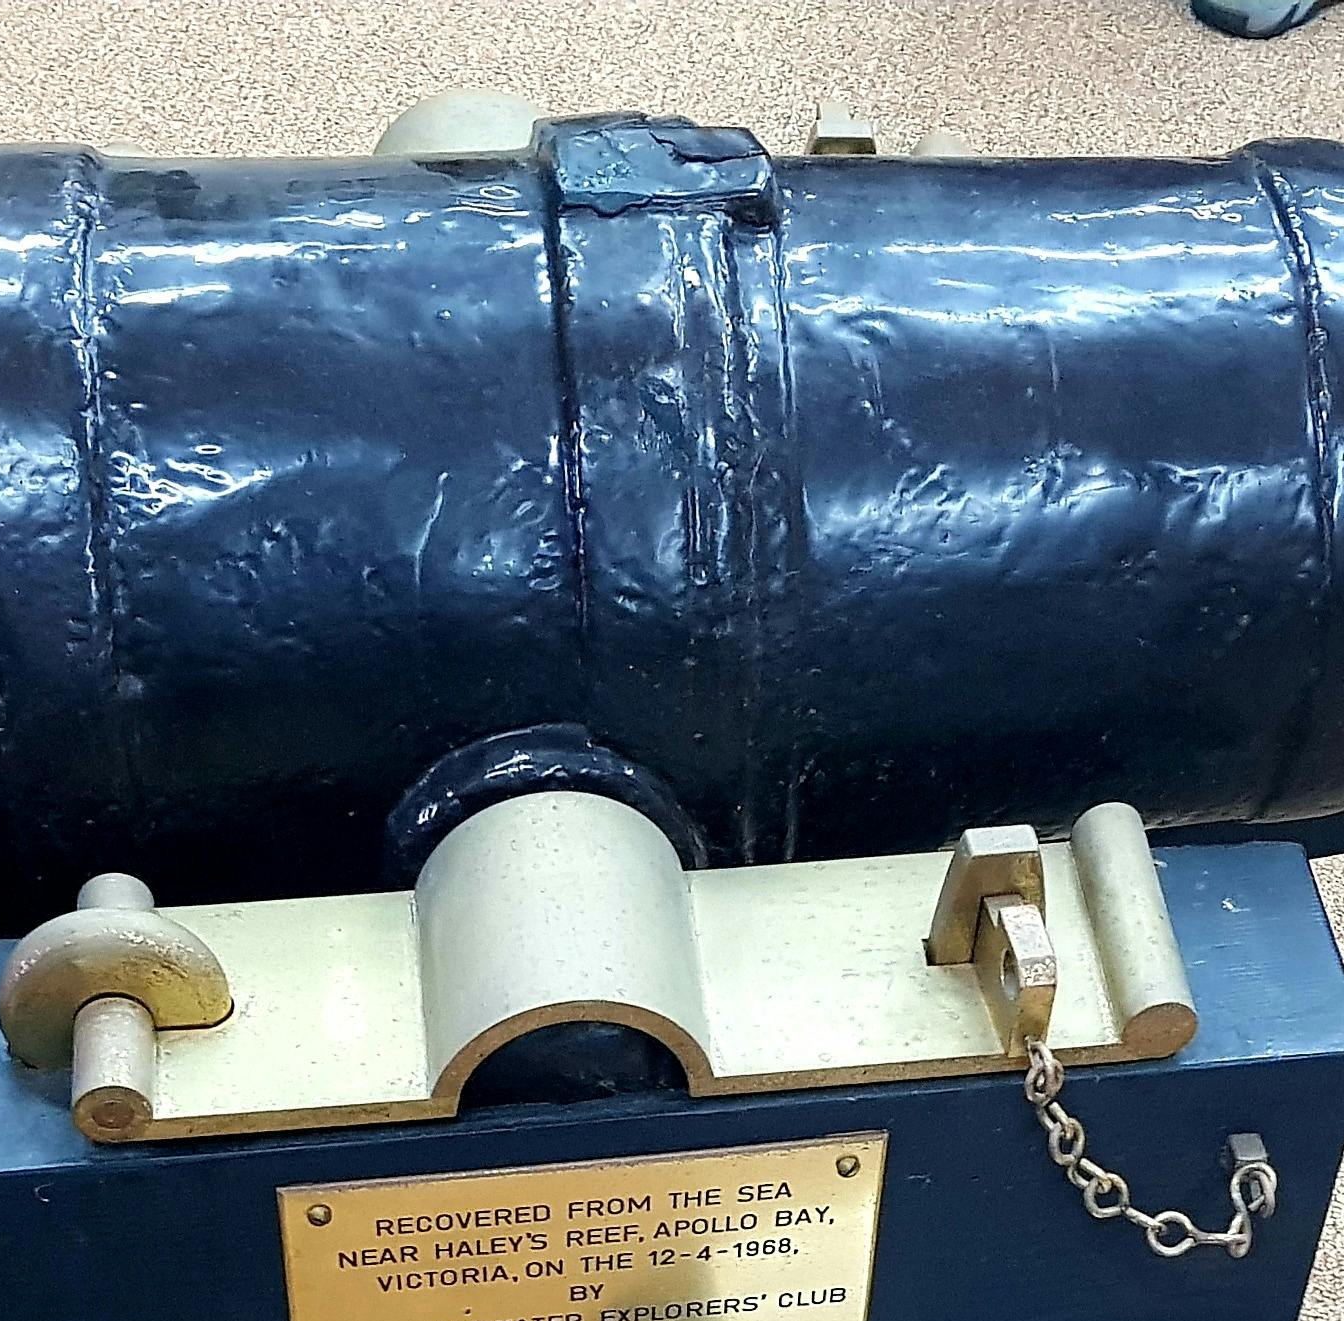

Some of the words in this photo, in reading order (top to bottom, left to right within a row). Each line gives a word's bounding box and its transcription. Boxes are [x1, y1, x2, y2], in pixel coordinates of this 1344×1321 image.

[375, 1204, 551, 1237] RECOVERED
[568, 1195, 651, 1220] FROM
[669, 1188, 721, 1209] THE
[737, 1182, 792, 1203] SEA
[338, 1245, 418, 1269] NEAR
[434, 1232, 548, 1260] HALEY'S
[567, 1224, 645, 1248] REEF,
[653, 1213, 758, 1239] APOLLO
[775, 1206, 835, 1227] BAY,
[377, 1265, 518, 1292] VICTORIA,
[525, 1259, 564, 1278] ON
[582, 1252, 633, 1274] THE
[648, 1237, 799, 1267] 12-4-1968,
[570, 1284, 604, 1301] BY
[778, 1287, 847, 1308] CLUB
